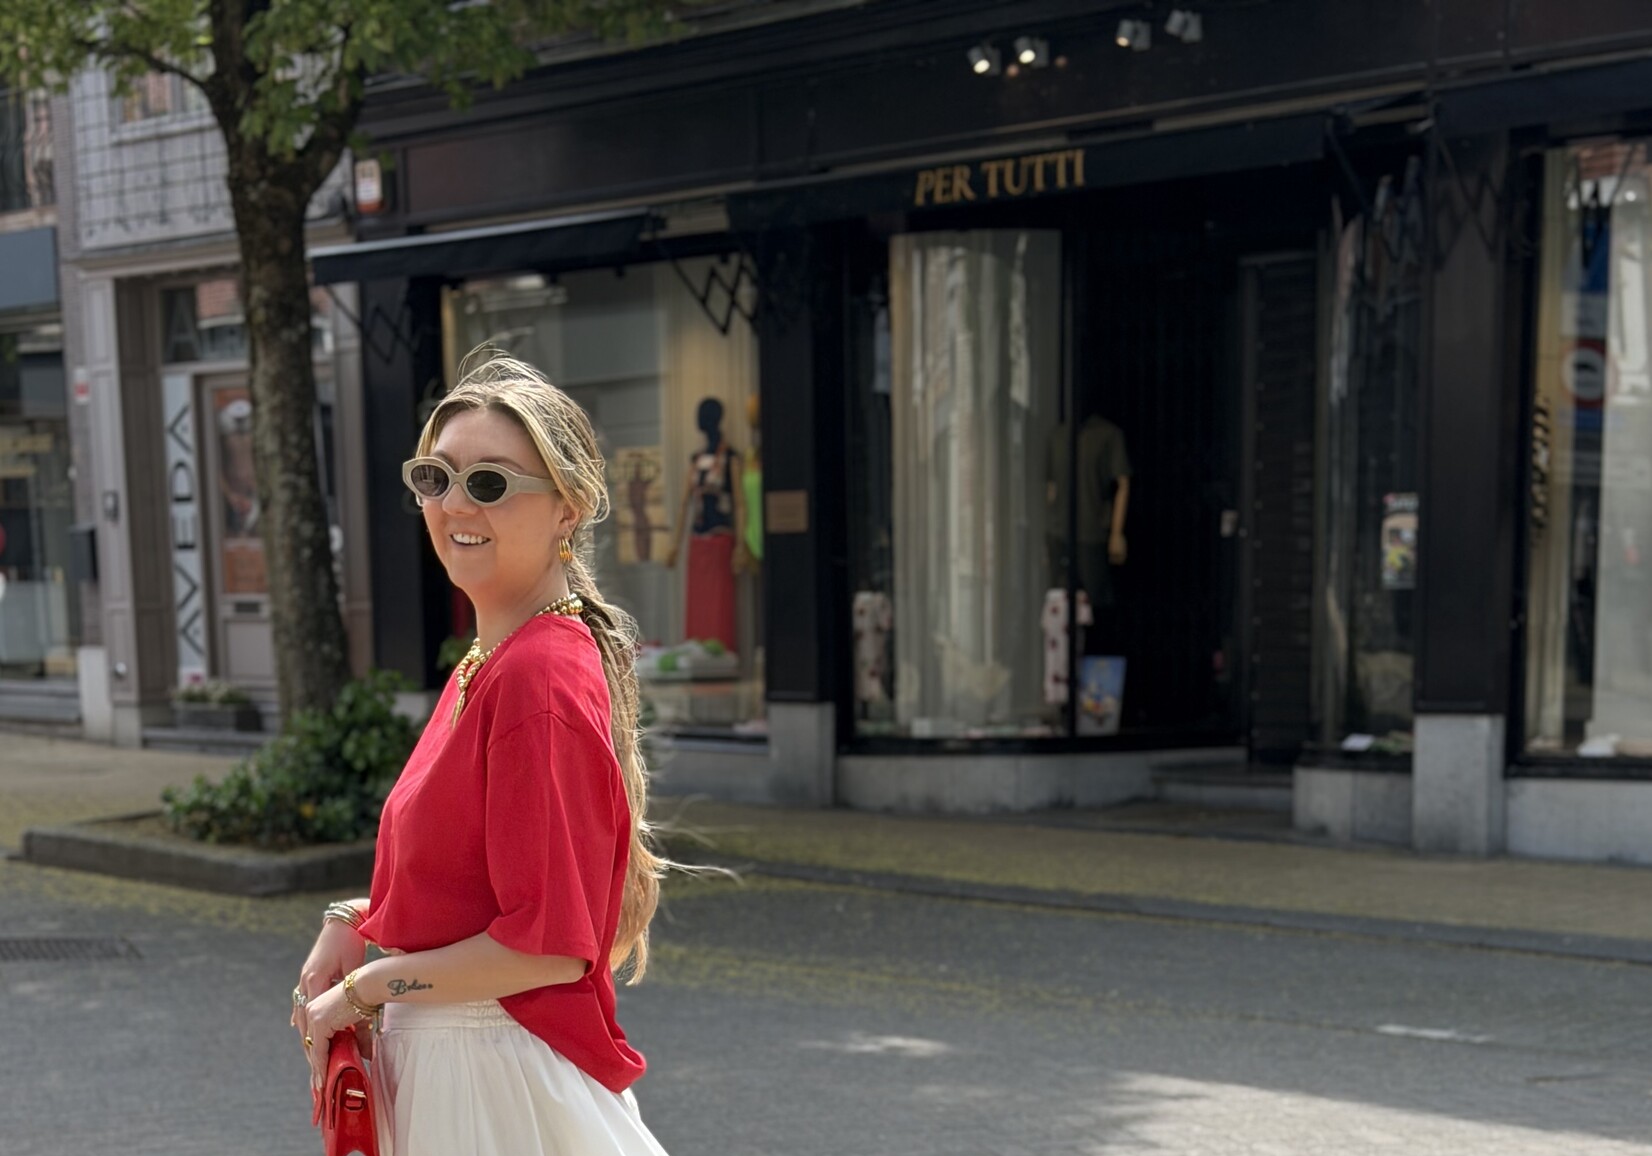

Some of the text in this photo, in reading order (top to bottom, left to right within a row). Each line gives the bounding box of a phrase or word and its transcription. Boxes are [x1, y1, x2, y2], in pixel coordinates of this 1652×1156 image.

[914, 149, 1085, 206] PER TUTTI
[167, 404, 204, 656] AVEDA
